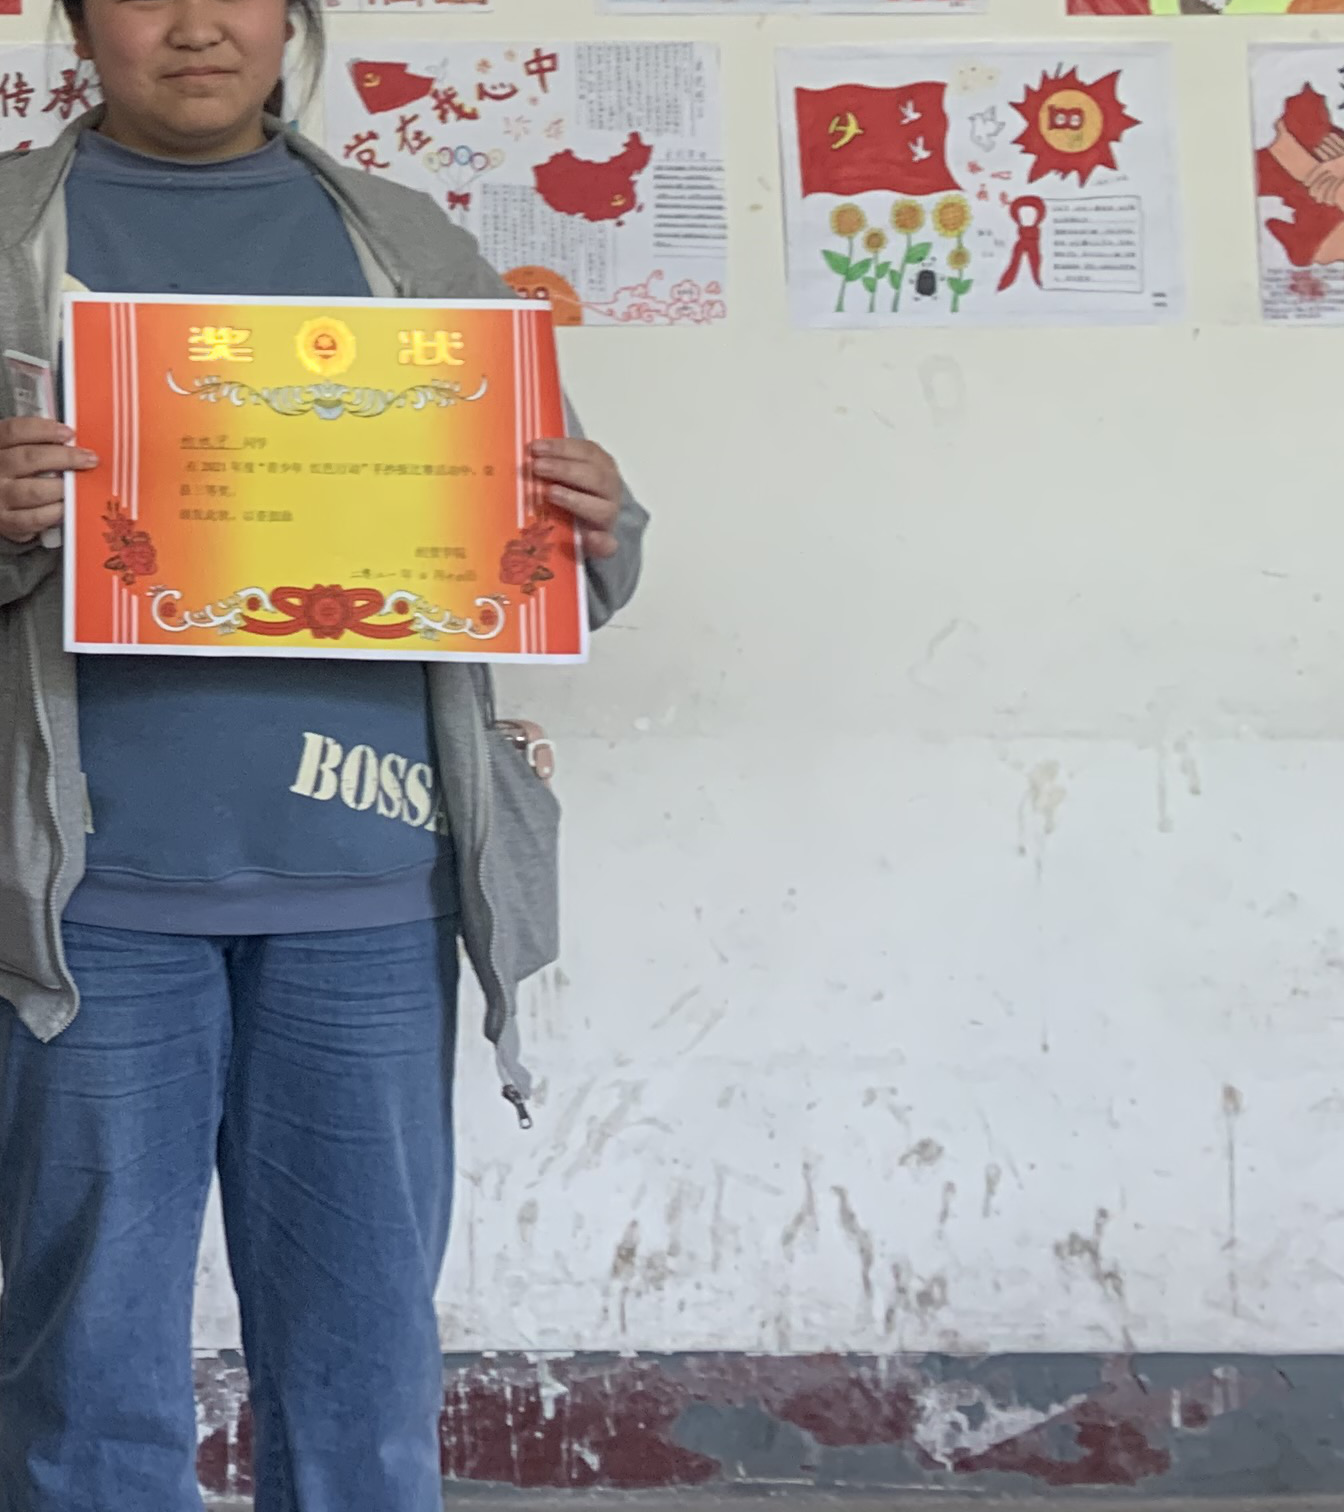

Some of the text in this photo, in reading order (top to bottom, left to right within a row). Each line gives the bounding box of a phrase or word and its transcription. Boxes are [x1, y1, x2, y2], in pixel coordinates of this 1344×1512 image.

[342, 48, 560, 174] 党在我心中
[188, 325, 465, 366] 奖 状
